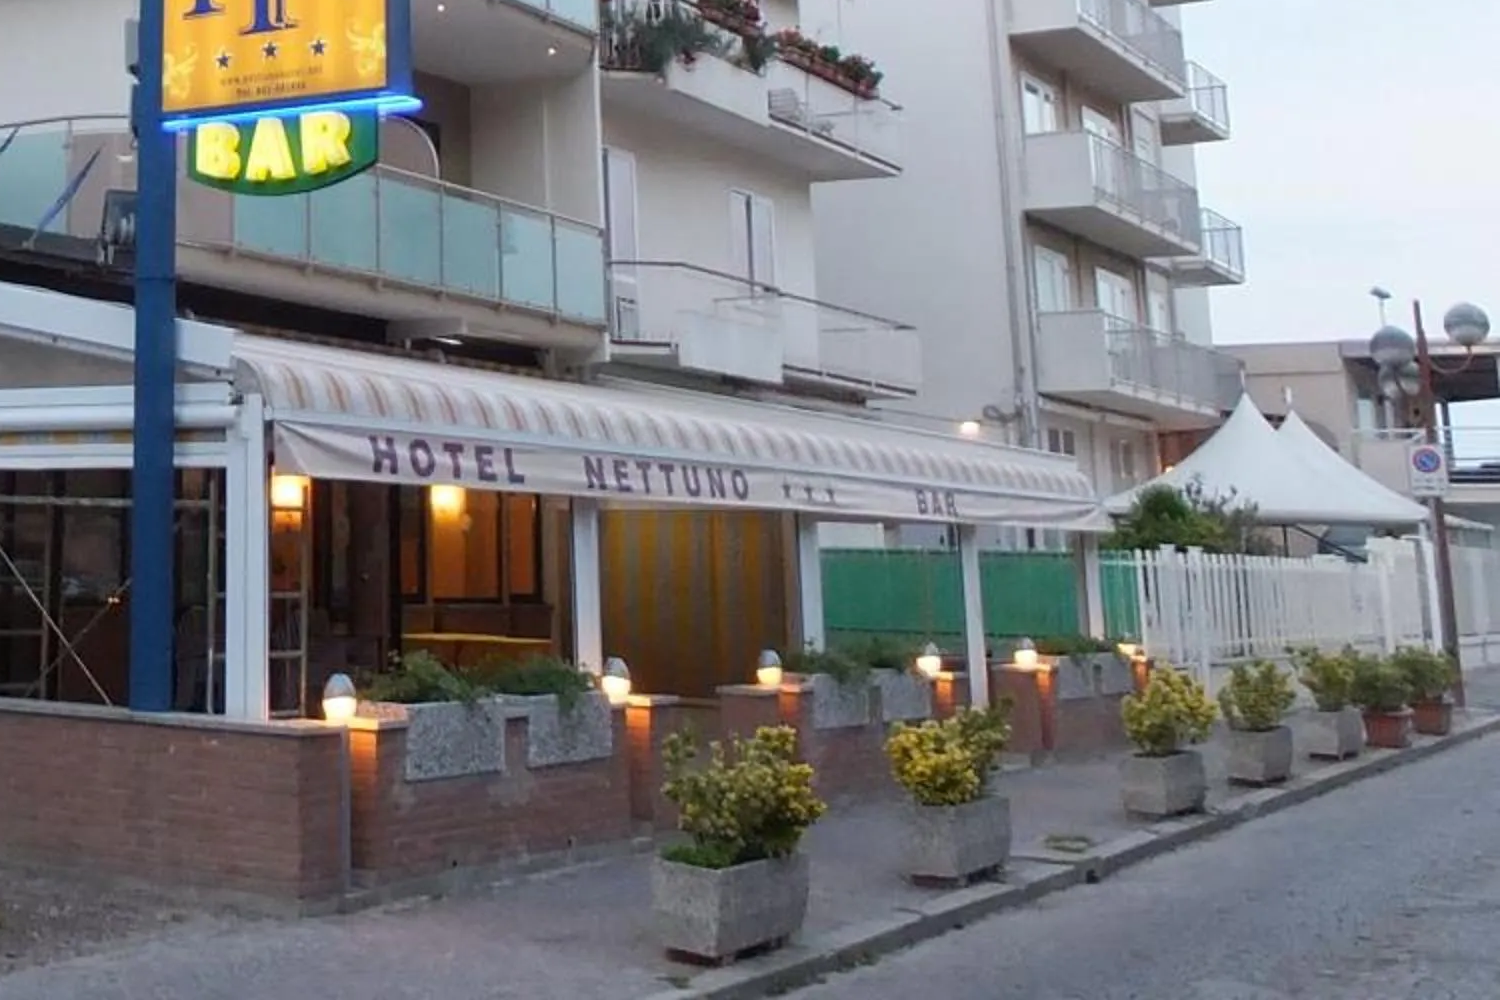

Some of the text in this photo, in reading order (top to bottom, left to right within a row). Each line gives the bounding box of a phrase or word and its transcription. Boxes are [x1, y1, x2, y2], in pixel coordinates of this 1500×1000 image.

[195, 111, 352, 182] BAR
[368, 434, 958, 518] HOTEL NETTUNO BAR
